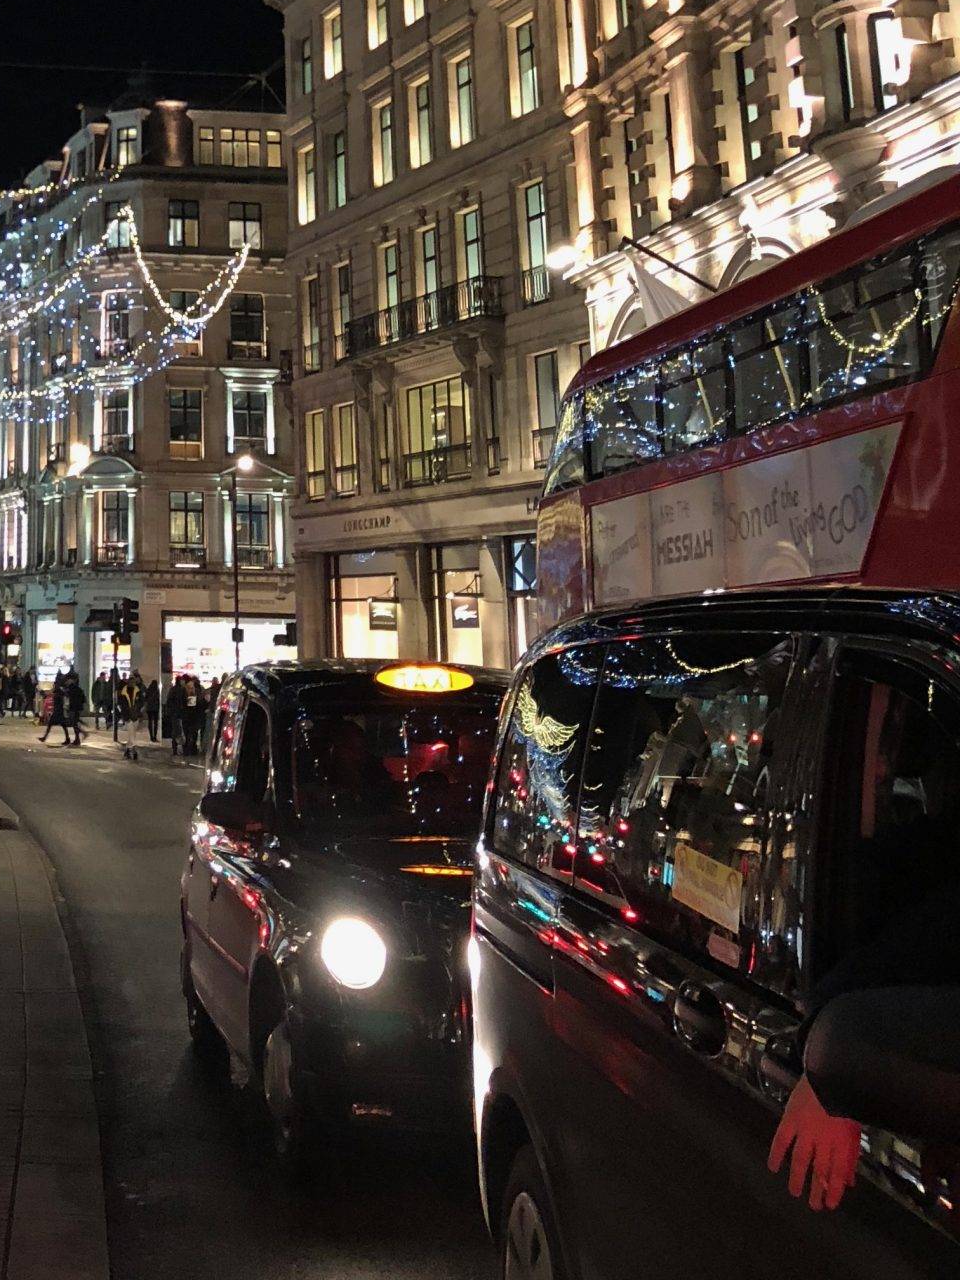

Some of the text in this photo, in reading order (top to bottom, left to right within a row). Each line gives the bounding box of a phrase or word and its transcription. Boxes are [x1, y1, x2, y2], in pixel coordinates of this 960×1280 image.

[828, 484, 868, 545] GOD
[656, 528, 714, 567] MESSIAH
[397, 671, 453, 689] TAXI
